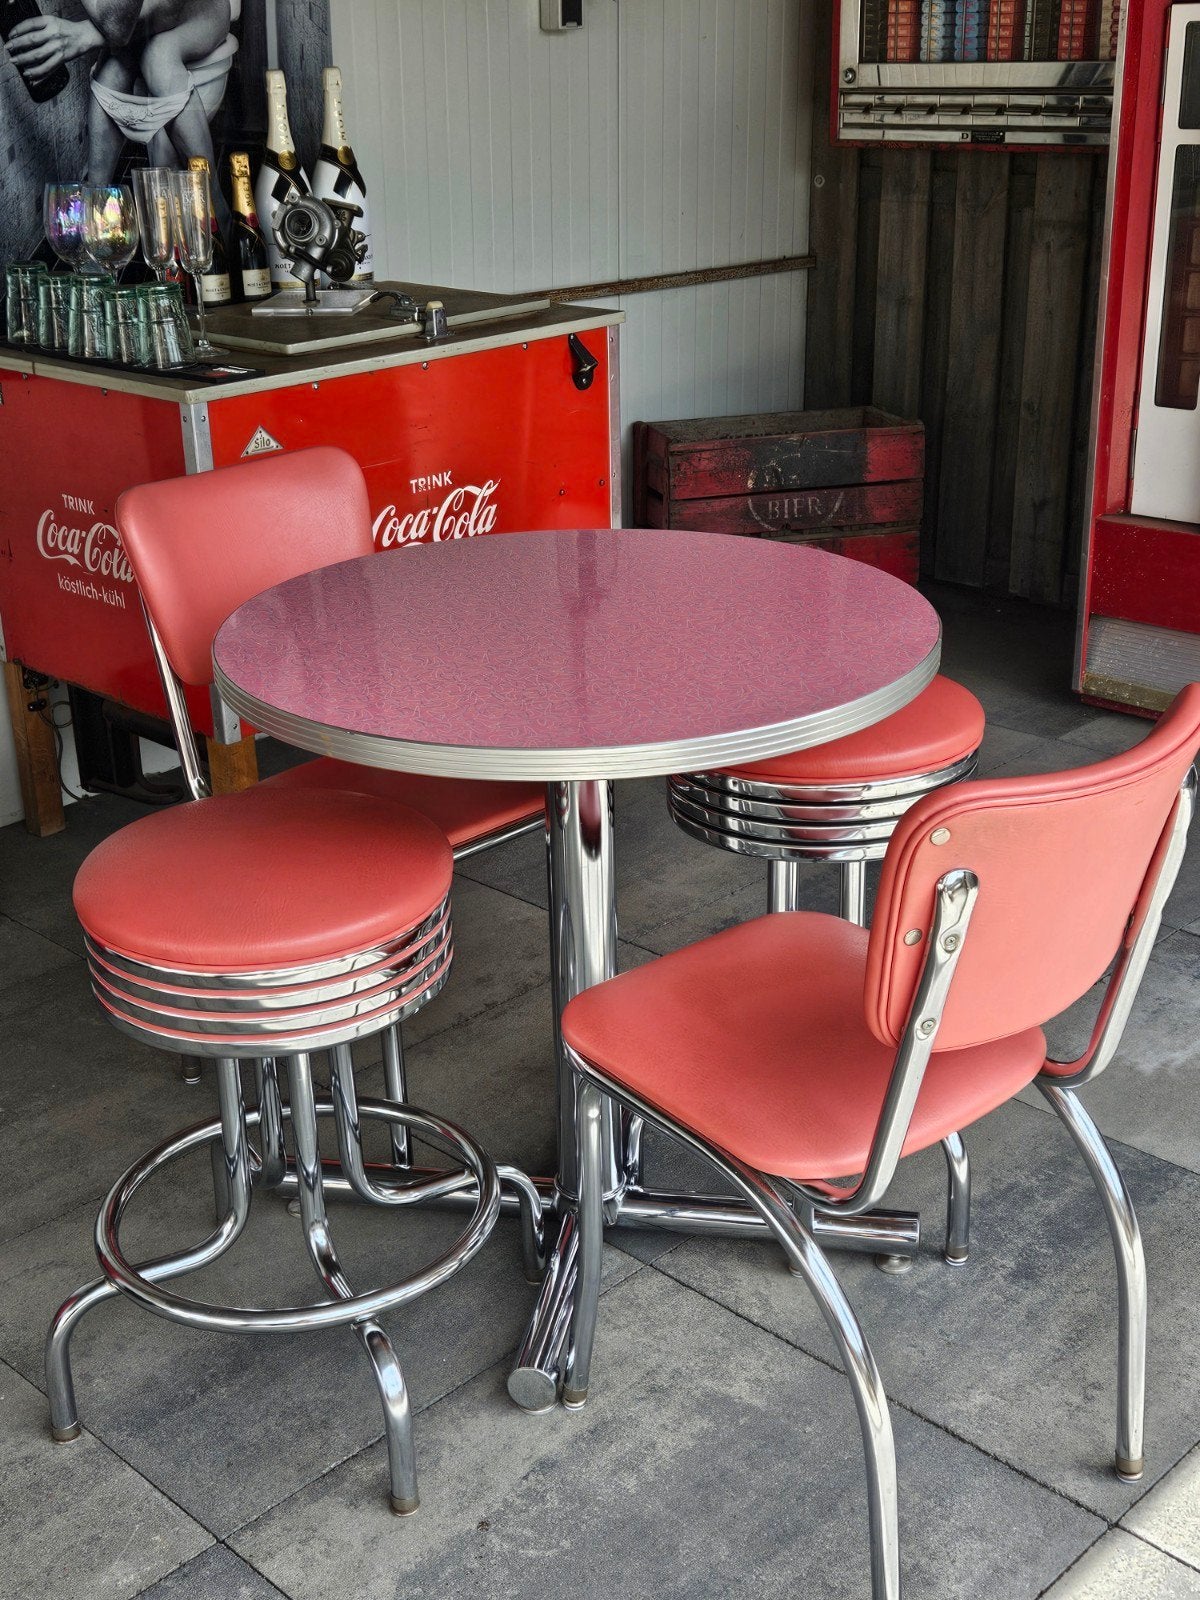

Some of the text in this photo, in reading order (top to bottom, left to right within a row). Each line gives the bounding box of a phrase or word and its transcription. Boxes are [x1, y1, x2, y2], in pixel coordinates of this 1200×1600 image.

[409, 470, 453, 494] TRINK
[61, 493, 95, 515] TRINK
[768, 496, 822, 520] BIER
[36, 509, 135, 583] Coca-Cola
[57, 573, 126, 609] köstlich-kühl
